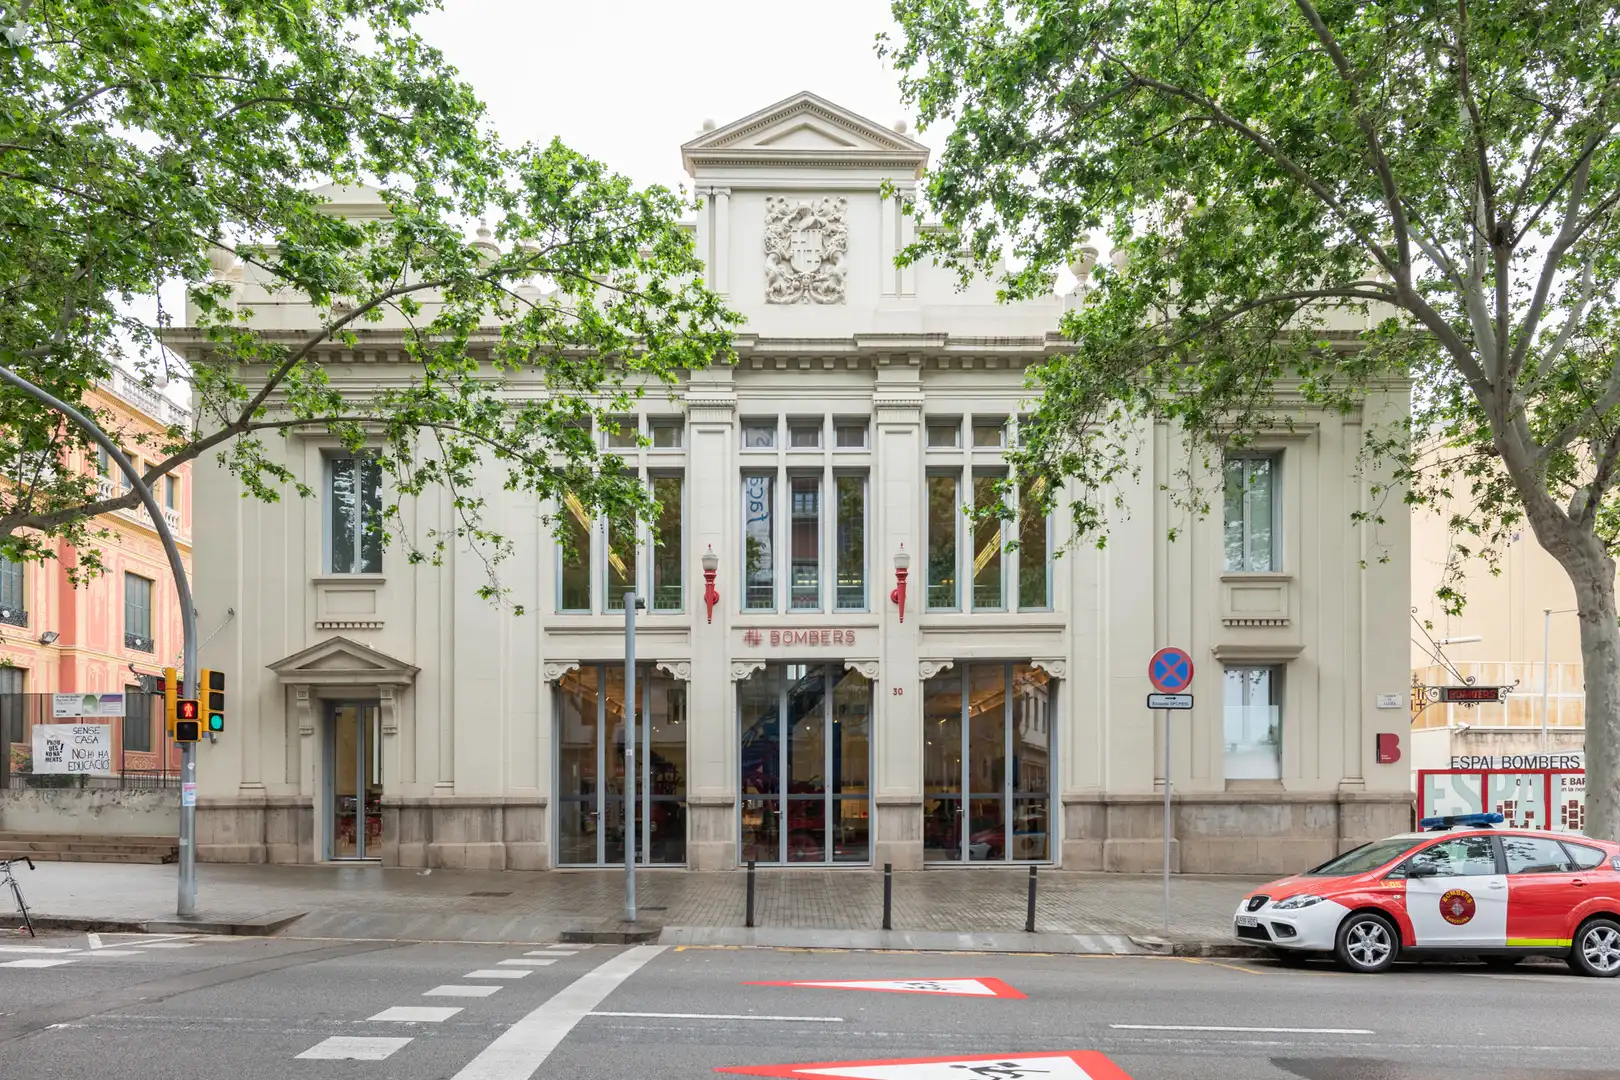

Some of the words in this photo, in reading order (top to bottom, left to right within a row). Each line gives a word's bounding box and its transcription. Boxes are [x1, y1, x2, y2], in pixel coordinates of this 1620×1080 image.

[769, 630, 856, 647] BOMBERS
[893, 687, 903, 696] 30
[73, 726, 100, 735] SENSE
[74, 735, 99, 744] CASA
[72, 748, 86, 759] NO
[1451, 756, 1493, 769] ESPAI
[1502, 755, 1580, 769] BOMBERS
[1442, 889, 1473, 904] BOMBERS
